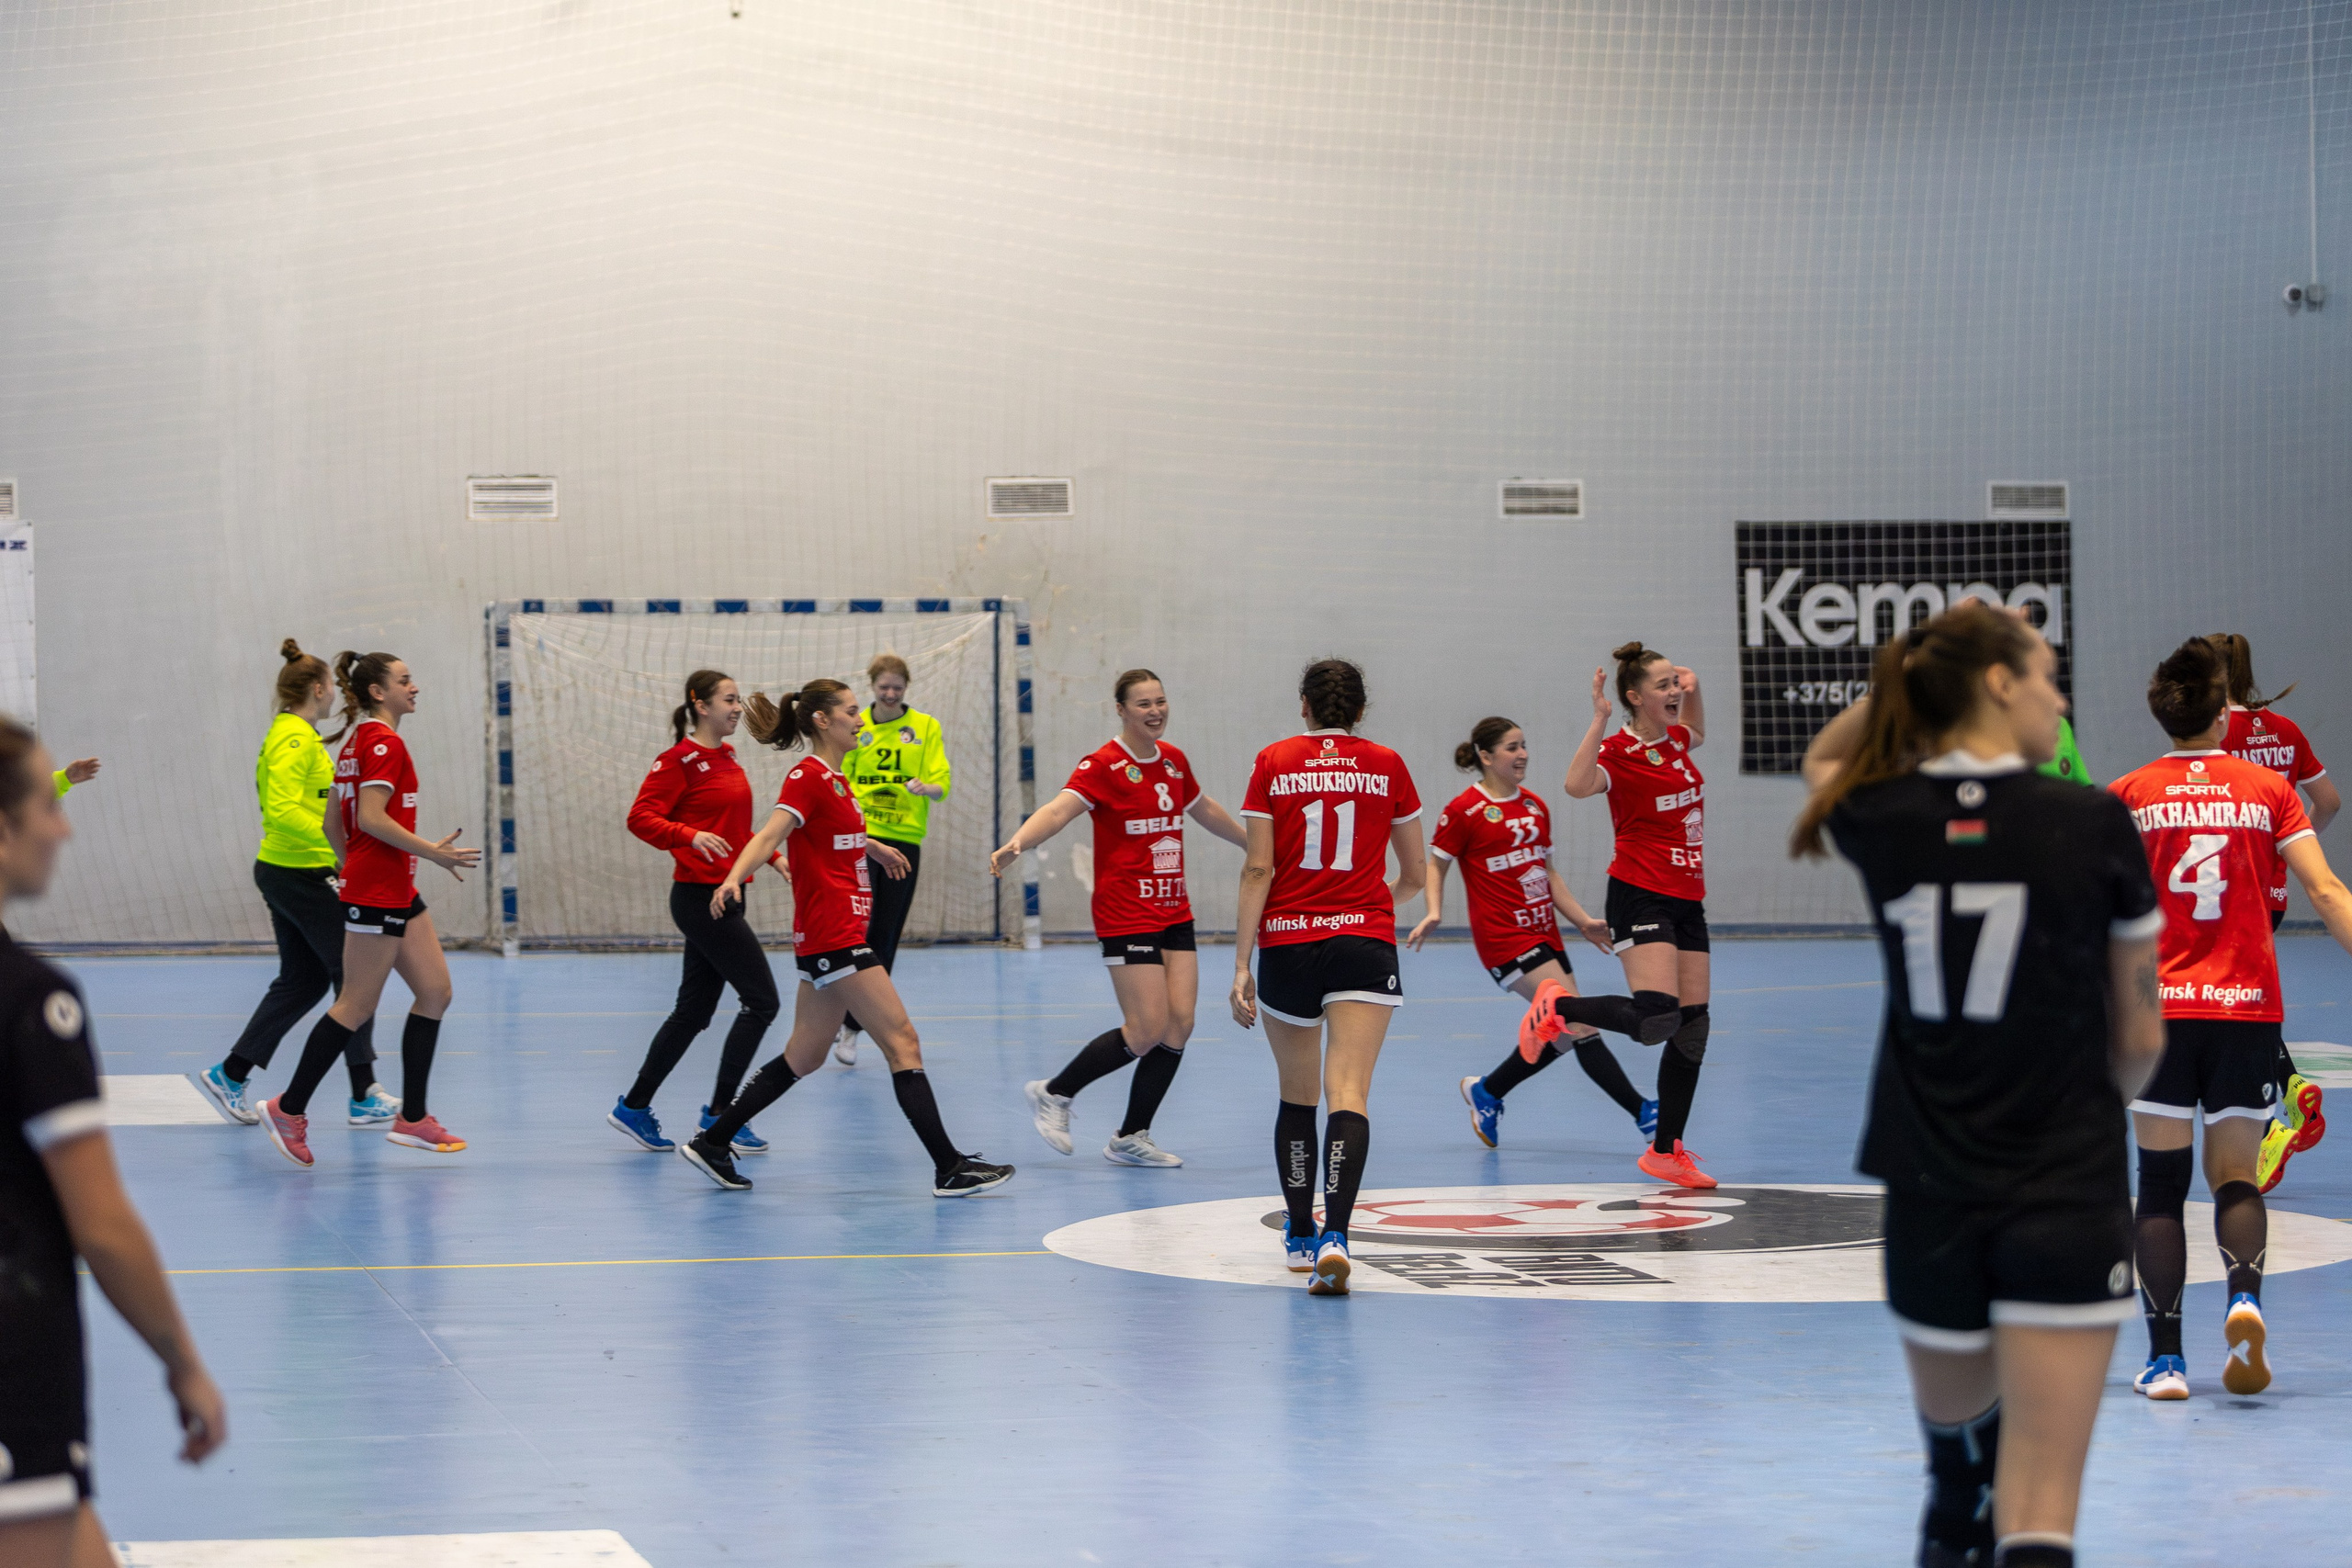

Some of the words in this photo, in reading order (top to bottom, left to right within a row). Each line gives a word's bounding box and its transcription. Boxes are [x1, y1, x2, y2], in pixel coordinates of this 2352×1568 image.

[1745, 567, 2063, 649] Kema
[876, 748, 901, 771] 21
[1305, 756, 1358, 770] SPORTIX
[1154, 783, 1174, 811] 8
[1269, 771, 1389, 797] ARTSIUKHOVICH
[2165, 783, 2233, 798] SPORTIX
[1298, 799, 1355, 871] 11
[1505, 816, 1540, 847] 33
[2168, 834, 2229, 920] 4
[1265, 915, 1307, 932] Minsk
[1312, 913, 1364, 931] Region
[1881, 882, 2030, 1023] 17
[2157, 981, 2197, 999] insk
[2201, 984, 2263, 1006] Region
[1287, 1140, 1309, 1188] Kempa
[1326, 1140, 1346, 1194] Kempa
